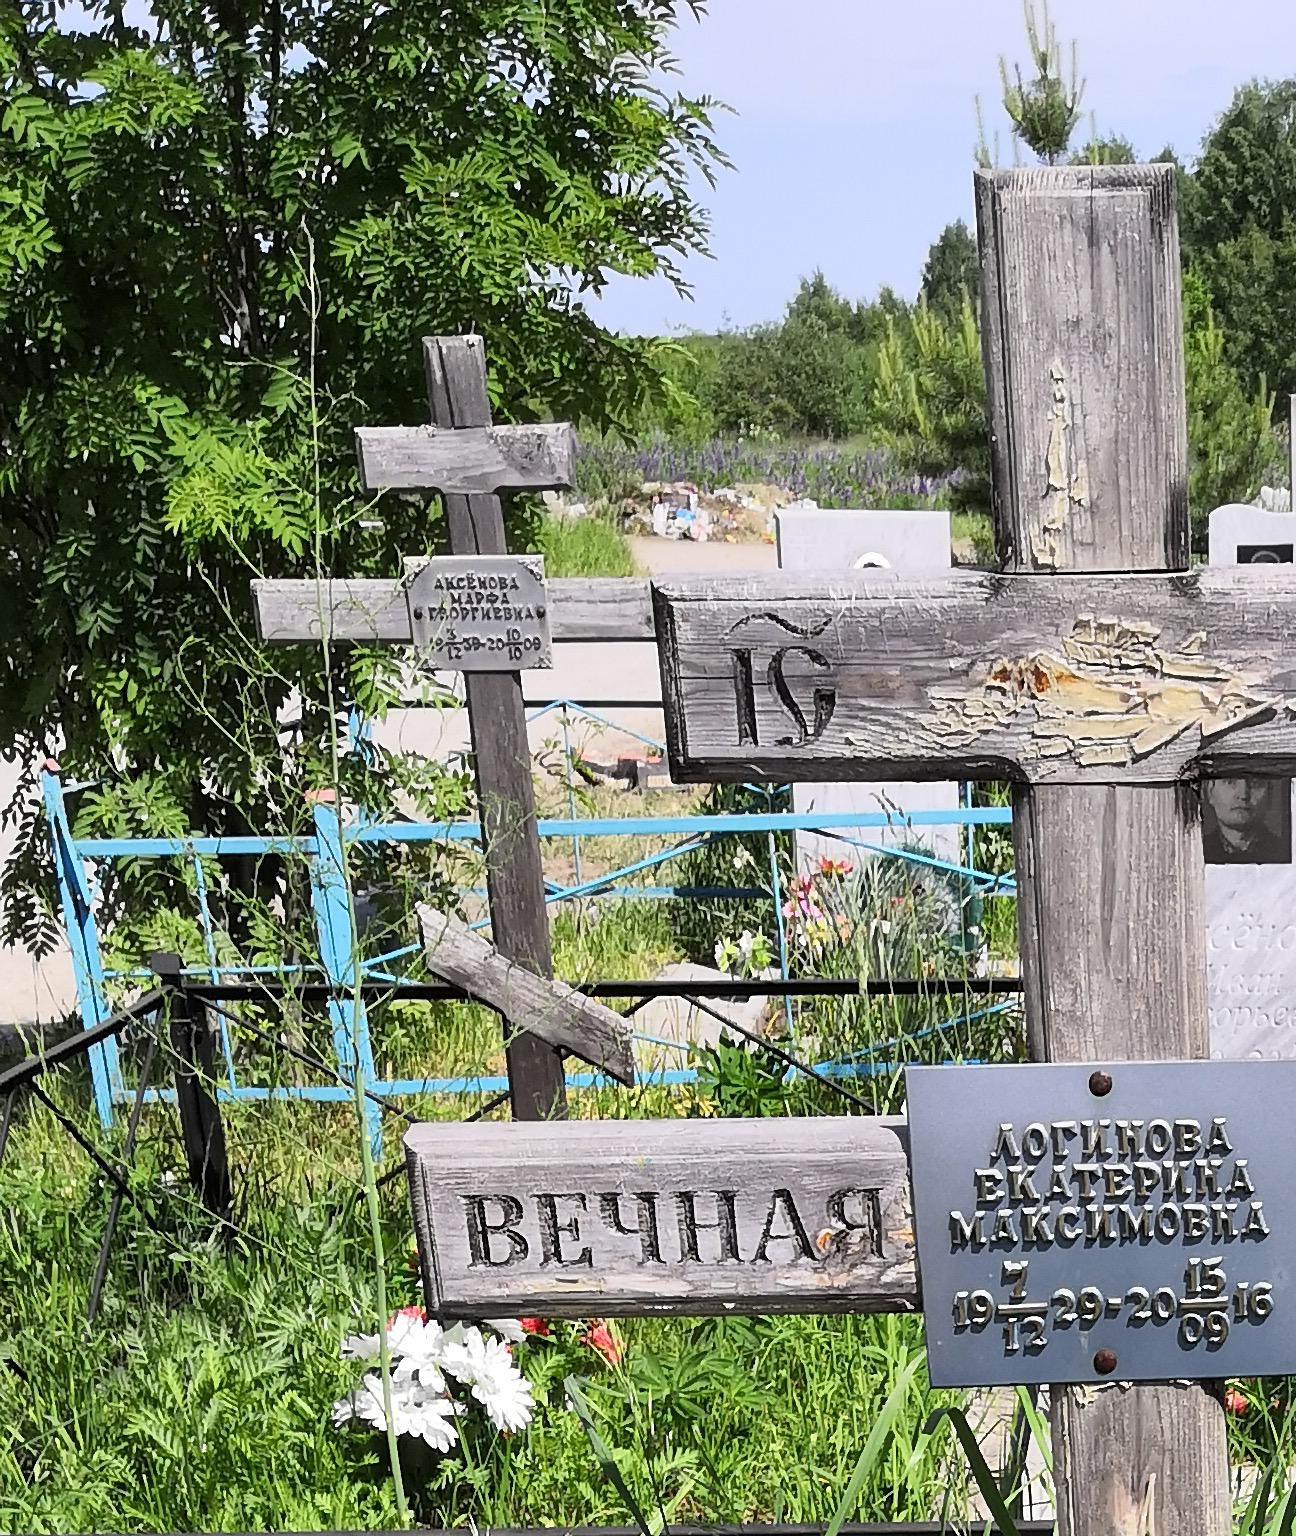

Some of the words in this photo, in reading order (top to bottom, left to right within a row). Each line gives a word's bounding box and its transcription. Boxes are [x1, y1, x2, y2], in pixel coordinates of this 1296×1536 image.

[450, 591, 510, 606] МАРФА
[989, 1117, 1234, 1162] ЛОГИНОВА
[974, 1159, 1256, 1203] ЕКАТЕРИНА
[459, 1187, 886, 1268] ВЕЧНАЯ
[948, 1201, 1271, 1247] МАКСИМОВНА
[1184, 1255, 1227, 1294] 15
[1004, 1316, 1048, 1350] 12
[1181, 1311, 1230, 1345] 09
